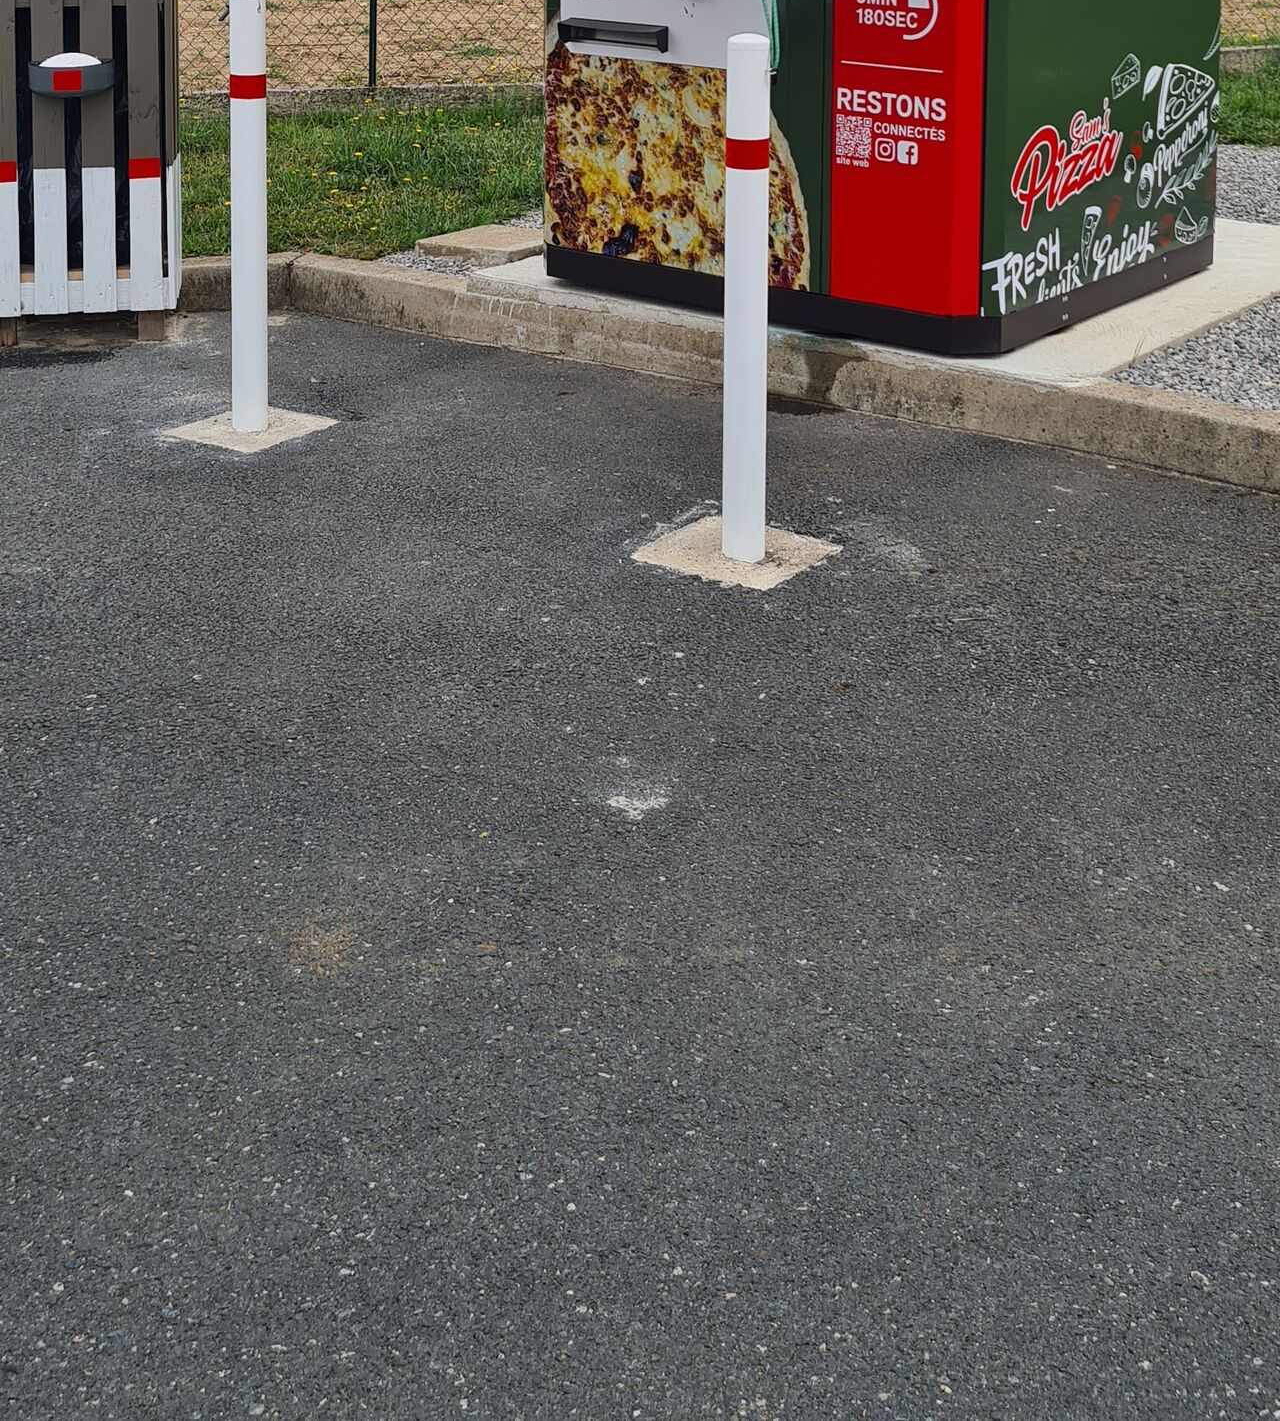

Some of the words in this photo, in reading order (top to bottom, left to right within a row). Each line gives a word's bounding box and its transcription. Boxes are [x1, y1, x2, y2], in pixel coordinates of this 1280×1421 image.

[856, 8, 918, 28] 180SEC
[836, 87, 947, 121] RESTONS
[874, 121, 946, 141] CONNECTÉS
[1069, 96, 1112, 152] Sam's
[836, 156, 850, 166] site
[852, 158, 869, 168] web
[1153, 100, 1209, 188] Pepperoni
[1011, 124, 1124, 232] Pizza
[981, 227, 1061, 315] FRESH
[1092, 220, 1156, 282] Enjoy
